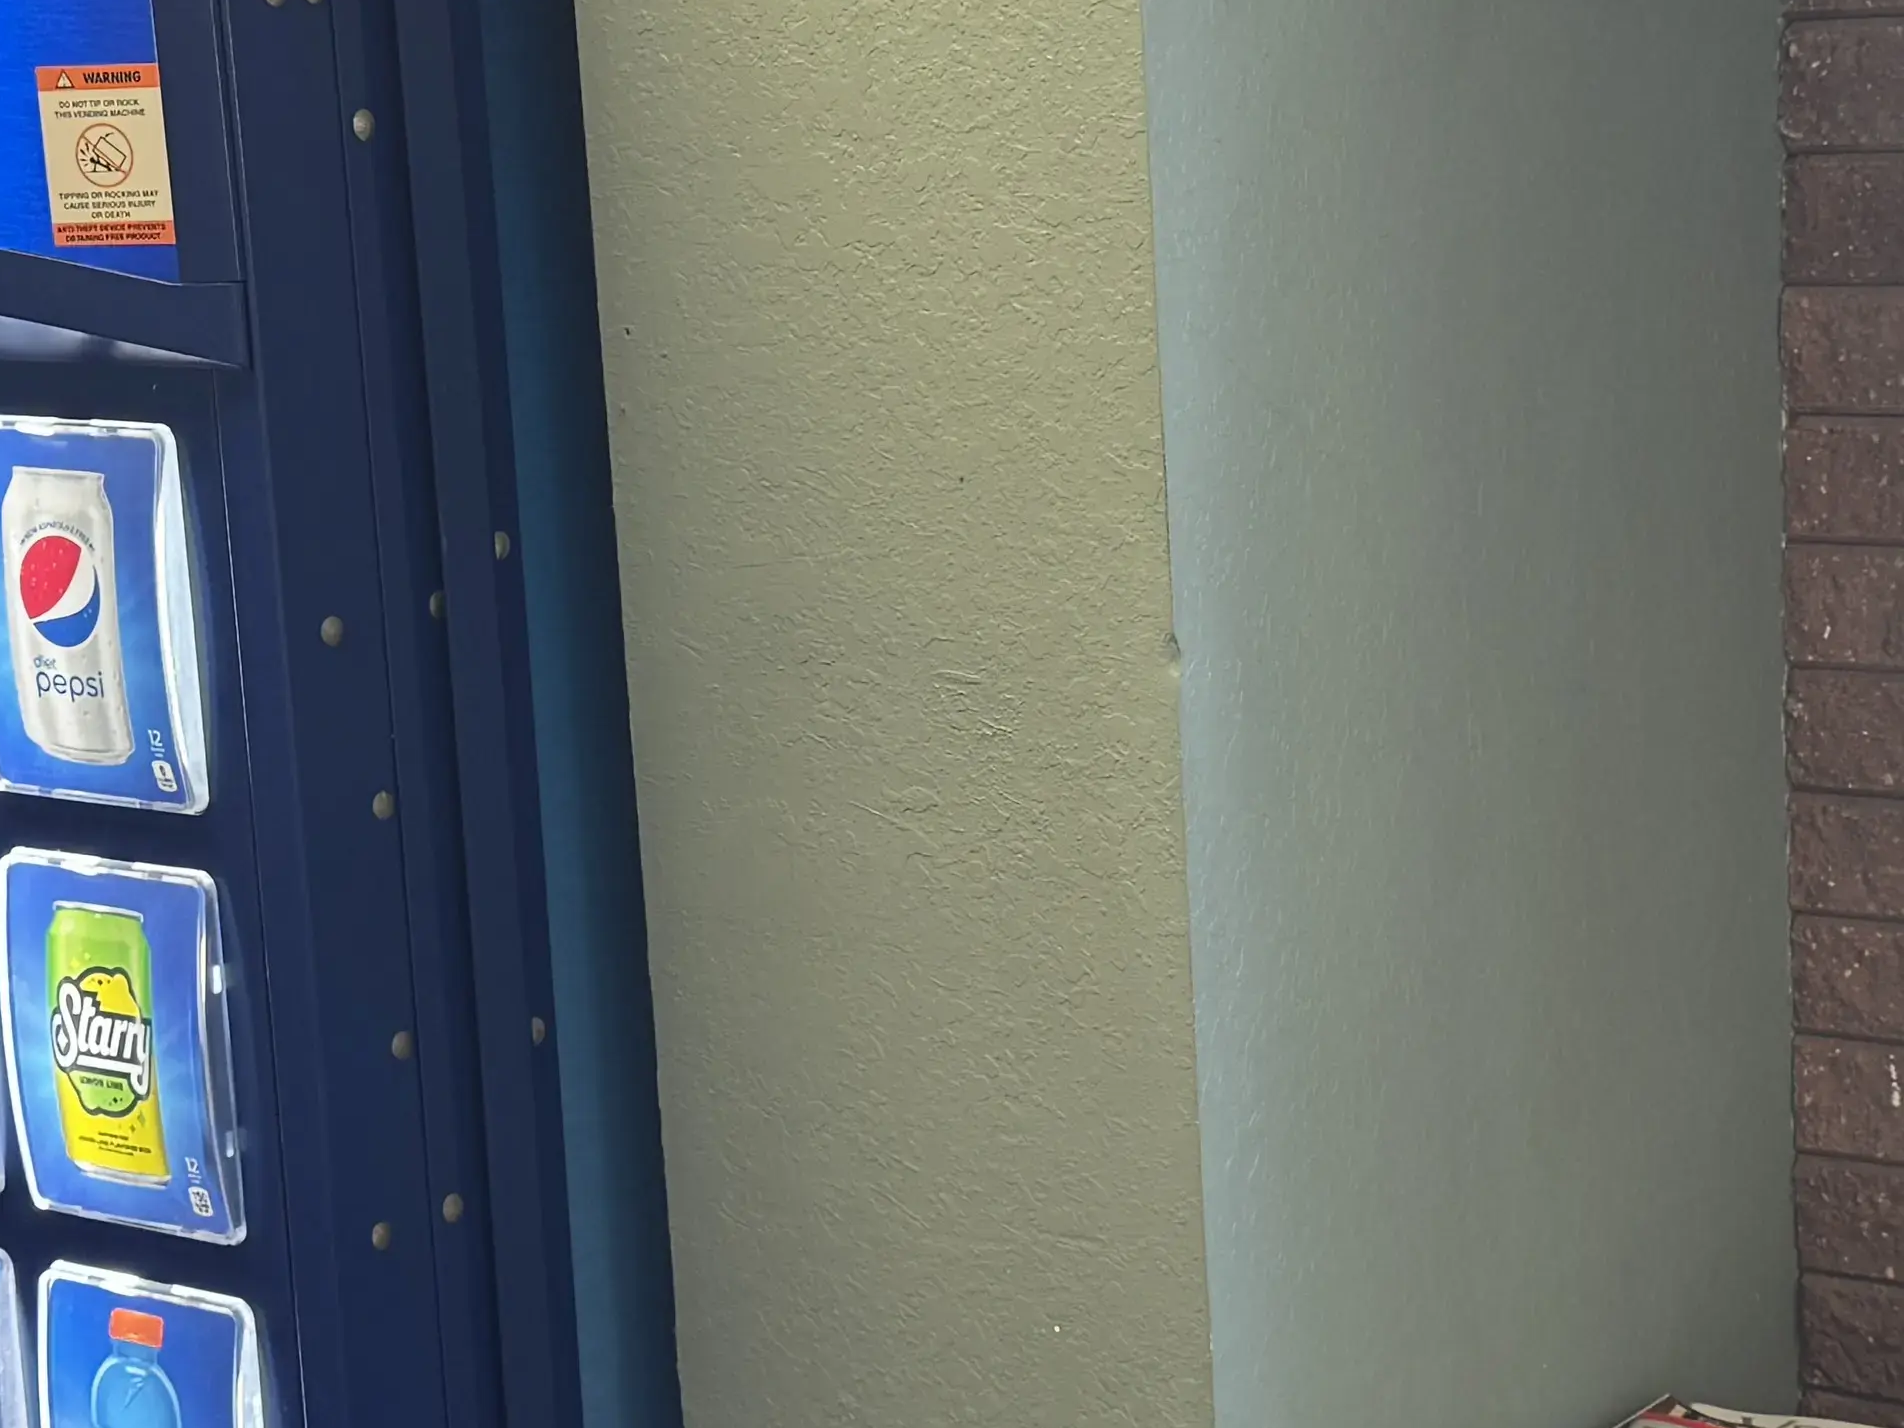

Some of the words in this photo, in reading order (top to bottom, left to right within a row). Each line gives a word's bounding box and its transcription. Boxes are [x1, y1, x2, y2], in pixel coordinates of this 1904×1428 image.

[83, 71, 141, 84] WARNING
[59, 100, 70, 109] DO
[72, 100, 89, 109] NOT
[90, 99, 101, 108] TIP
[103, 99, 115, 108] OR
[117, 99, 139, 107] ROCK
[54, 111, 72, 119] THIS
[74, 110, 108, 118] VENDING
[111, 108, 145, 117] MACHINE
[59, 192, 90, 200] TIPPING
[105, 191, 140, 199] ROCKING
[142, 190, 158, 198] MAY
[64, 201, 90, 209] CAUSE
[92, 200, 126, 209] SERIOUS
[128, 200, 156, 208] INJURY
[92, 211, 102, 219] OR
[105, 210, 131, 219] DEATH
[33, 655, 57, 670] diet
[36, 671, 105, 701] pepsi
[147, 729, 164, 748] 12
[53, 982, 152, 1099] Starry
